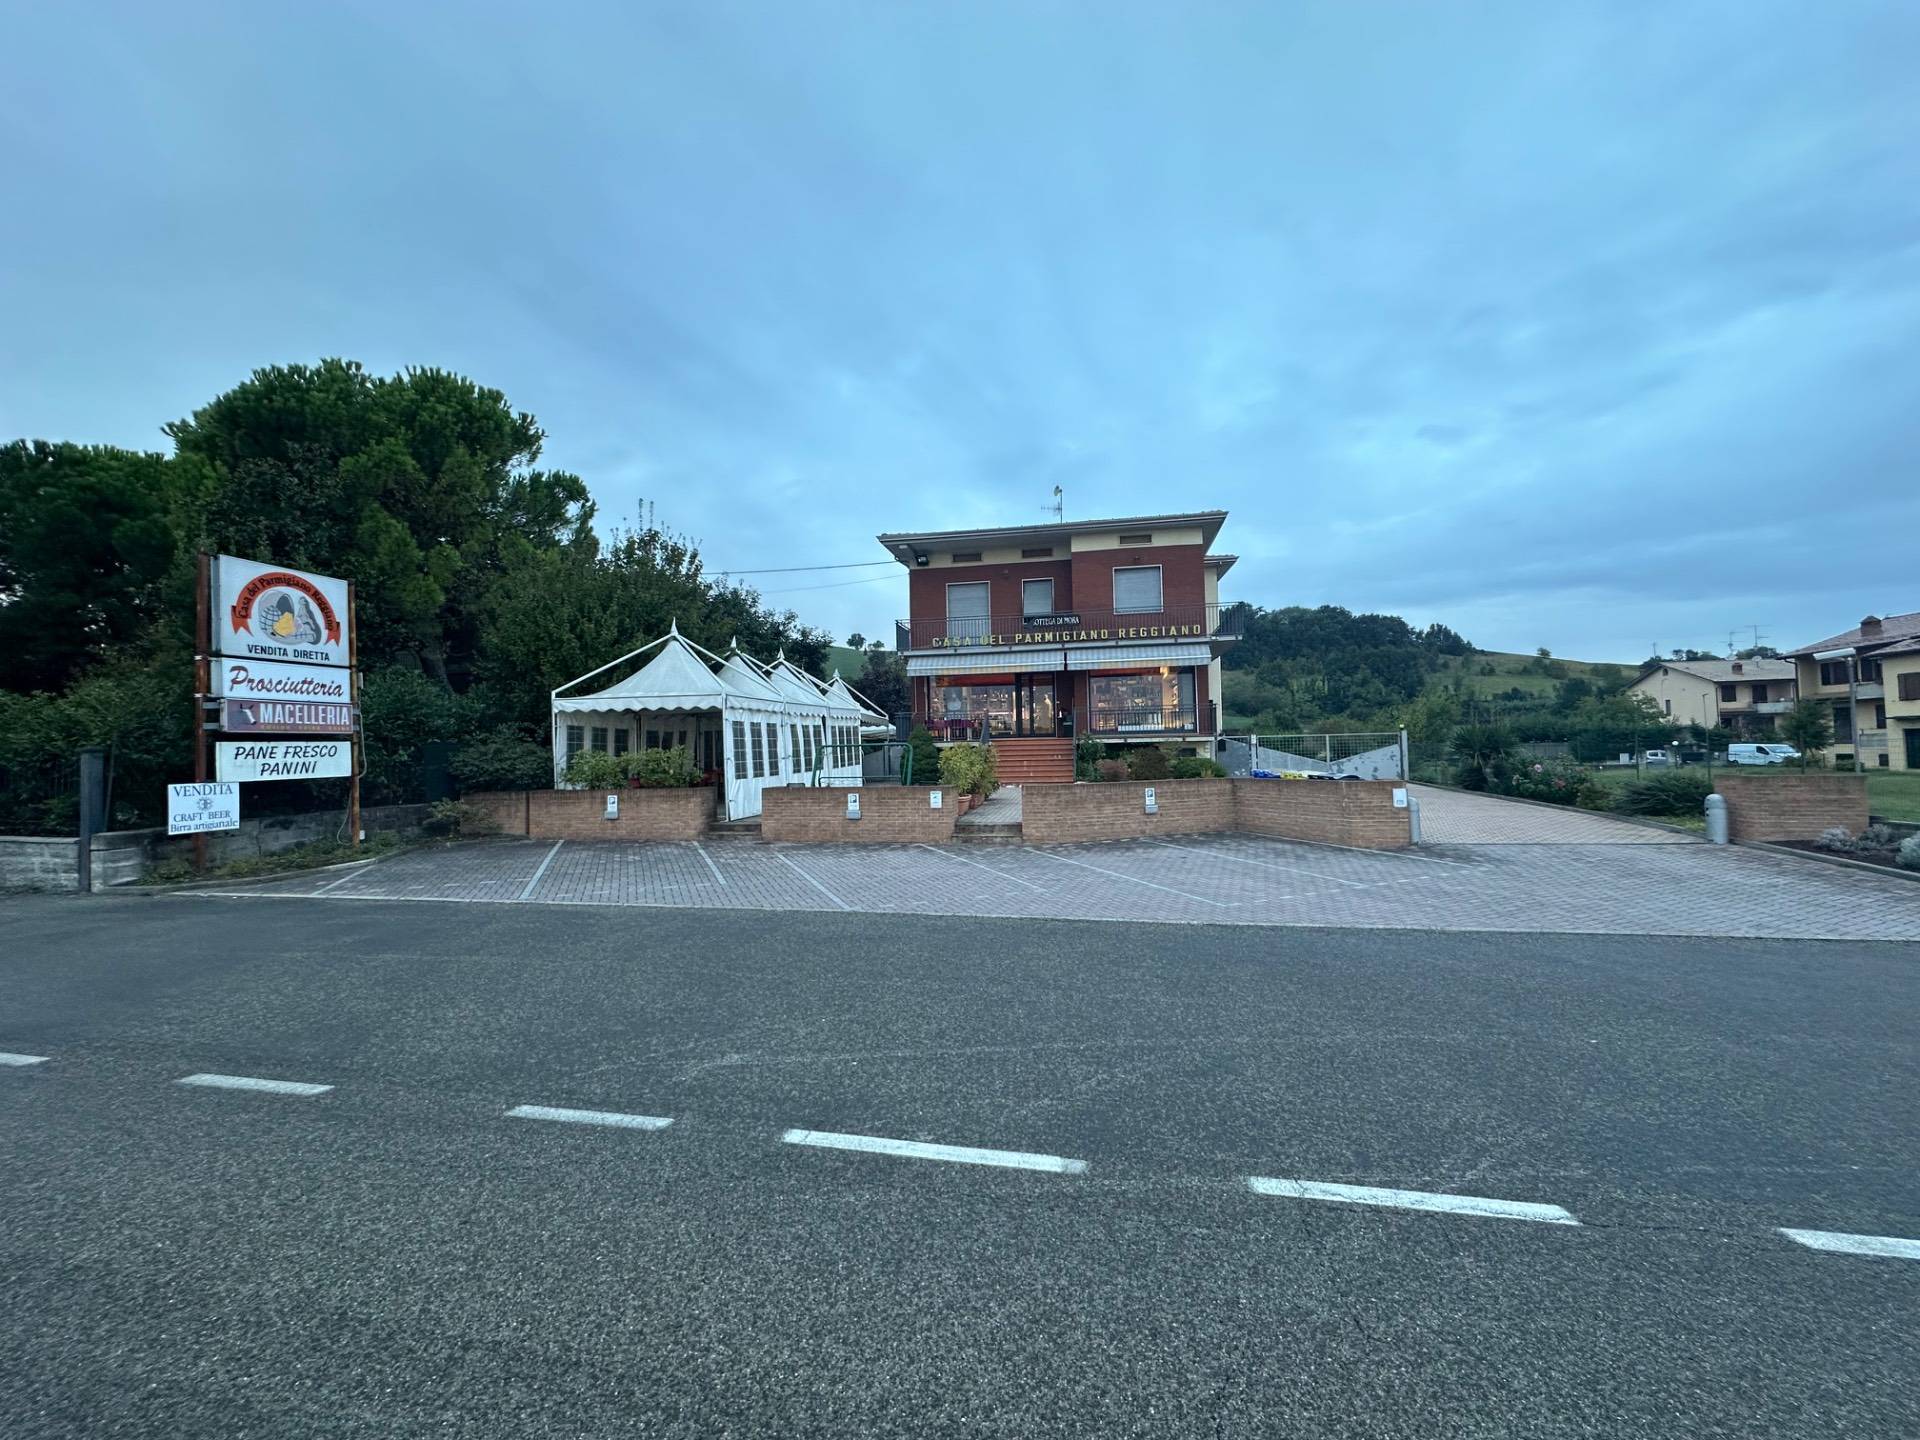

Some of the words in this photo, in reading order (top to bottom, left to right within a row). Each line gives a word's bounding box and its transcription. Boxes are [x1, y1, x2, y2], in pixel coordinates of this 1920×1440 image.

[238, 600, 250, 618] Casa
[247, 582, 260, 596] del
[259, 575, 311, 593] Parmigiano
[311, 590, 334, 631] Reggiano
[1032, 617, 1056, 626] OTTEGA
[932, 636, 971, 648] CASA
[981, 634, 1006, 646] DEL
[1015, 629, 1109, 644] PARMIGIANO
[1118, 624, 1201, 639] REGGIANO
[247, 644, 289, 658] VENDITA
[293, 649, 330, 662] DIRETTA
[229, 665, 344, 697] Prosciutteria
[260, 703, 350, 725] MACELLERIA
[234, 746, 278, 760] PANE
[283, 745, 338, 759] FRESCO
[260, 761, 317, 776] PANINI
[174, 784, 233, 797] VENDITA
[173, 811, 204, 823] CRAFT
[208, 810, 231, 820] BEER
[170, 823, 192, 833] Birra
[194, 818, 239, 831] artigianale
